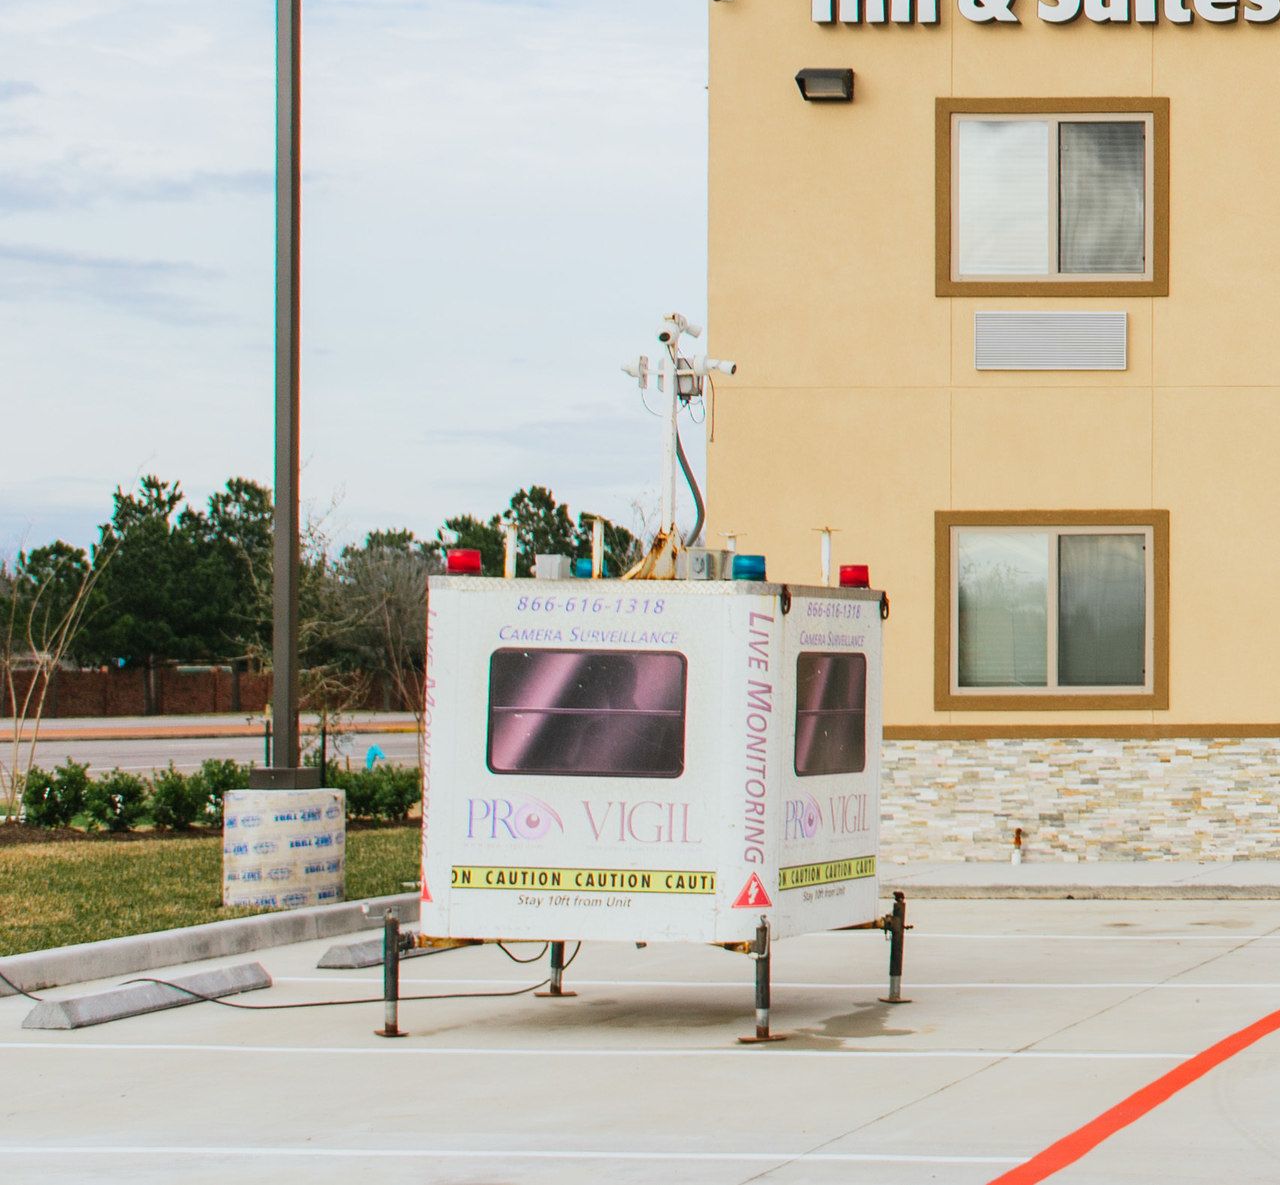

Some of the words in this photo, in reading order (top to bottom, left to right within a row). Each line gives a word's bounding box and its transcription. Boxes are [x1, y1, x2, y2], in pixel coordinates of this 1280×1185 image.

[517, 596, 666, 615] 866-616-1318
[748, 611, 775, 672] LIVE
[744, 679, 773, 865] MONITORING
[581, 799, 703, 844] VIGIL
[829, 794, 870, 834] VIGIL
[485, 870, 562, 887] CAUTION
[574, 872, 652, 889] CAUTION
[791, 866, 821, 885] CAUTION
[825, 862, 852, 880] CAUTION
[517, 894, 543, 907] Stay
[549, 895, 571, 907] 10ft
[572, 895, 602, 907] from
[606, 896, 632, 908] Unit
